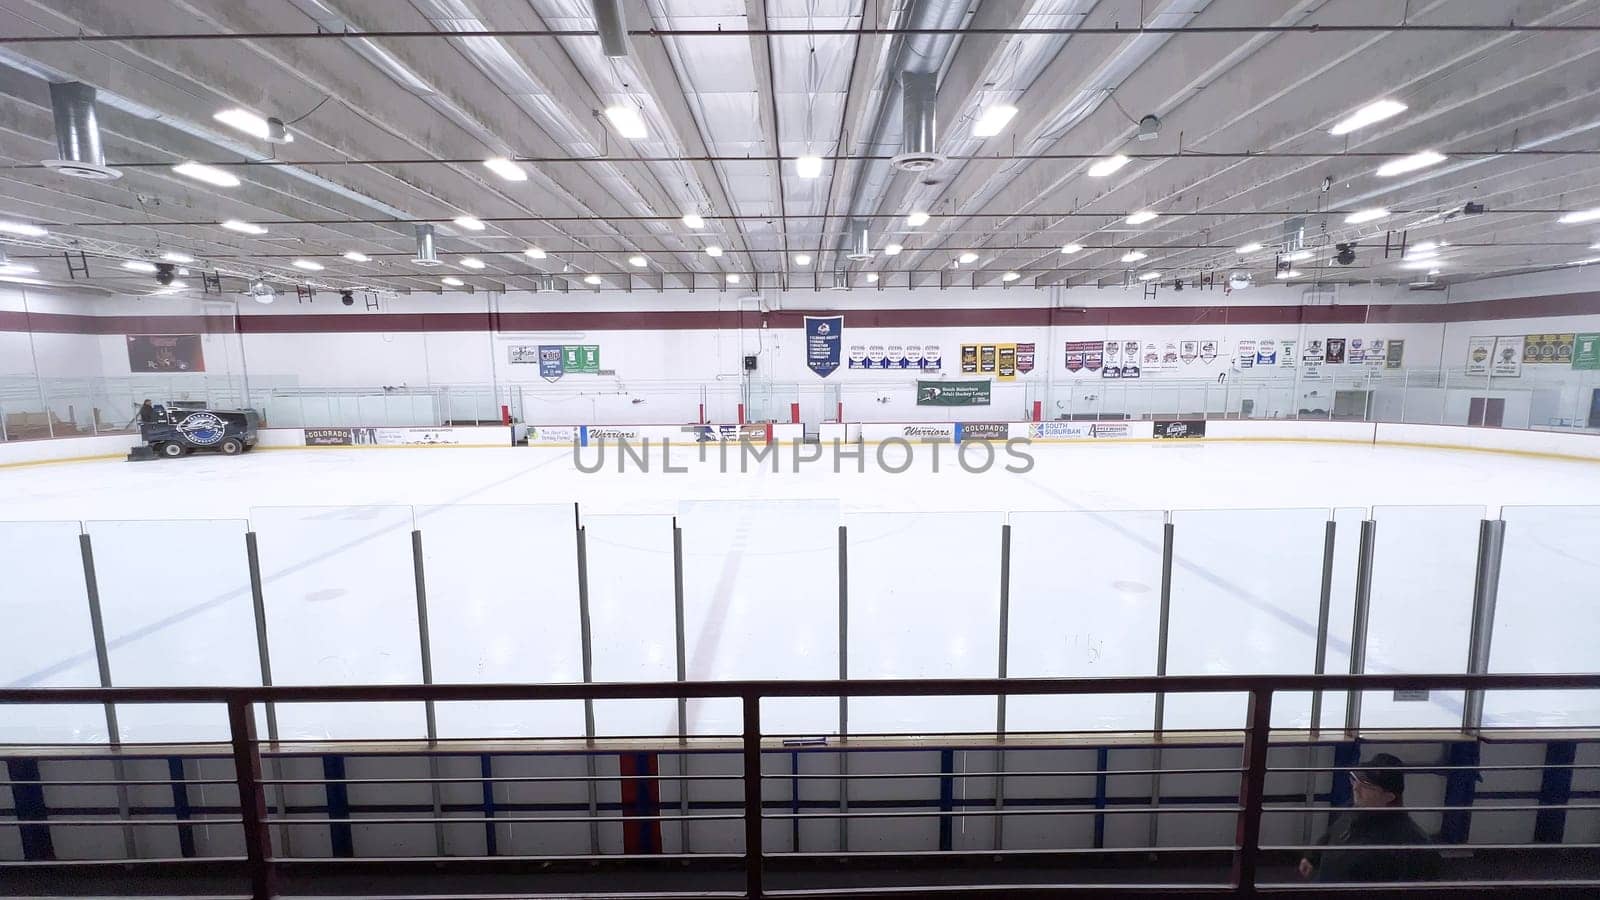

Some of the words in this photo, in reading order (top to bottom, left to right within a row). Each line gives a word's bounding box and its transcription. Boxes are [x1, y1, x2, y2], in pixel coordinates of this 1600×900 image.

[903, 426, 950, 436] Warriors
[965, 424, 1005, 433] COLORADO
[308, 430, 348, 438] COLORADO
[589, 429, 635, 439] Warriors
